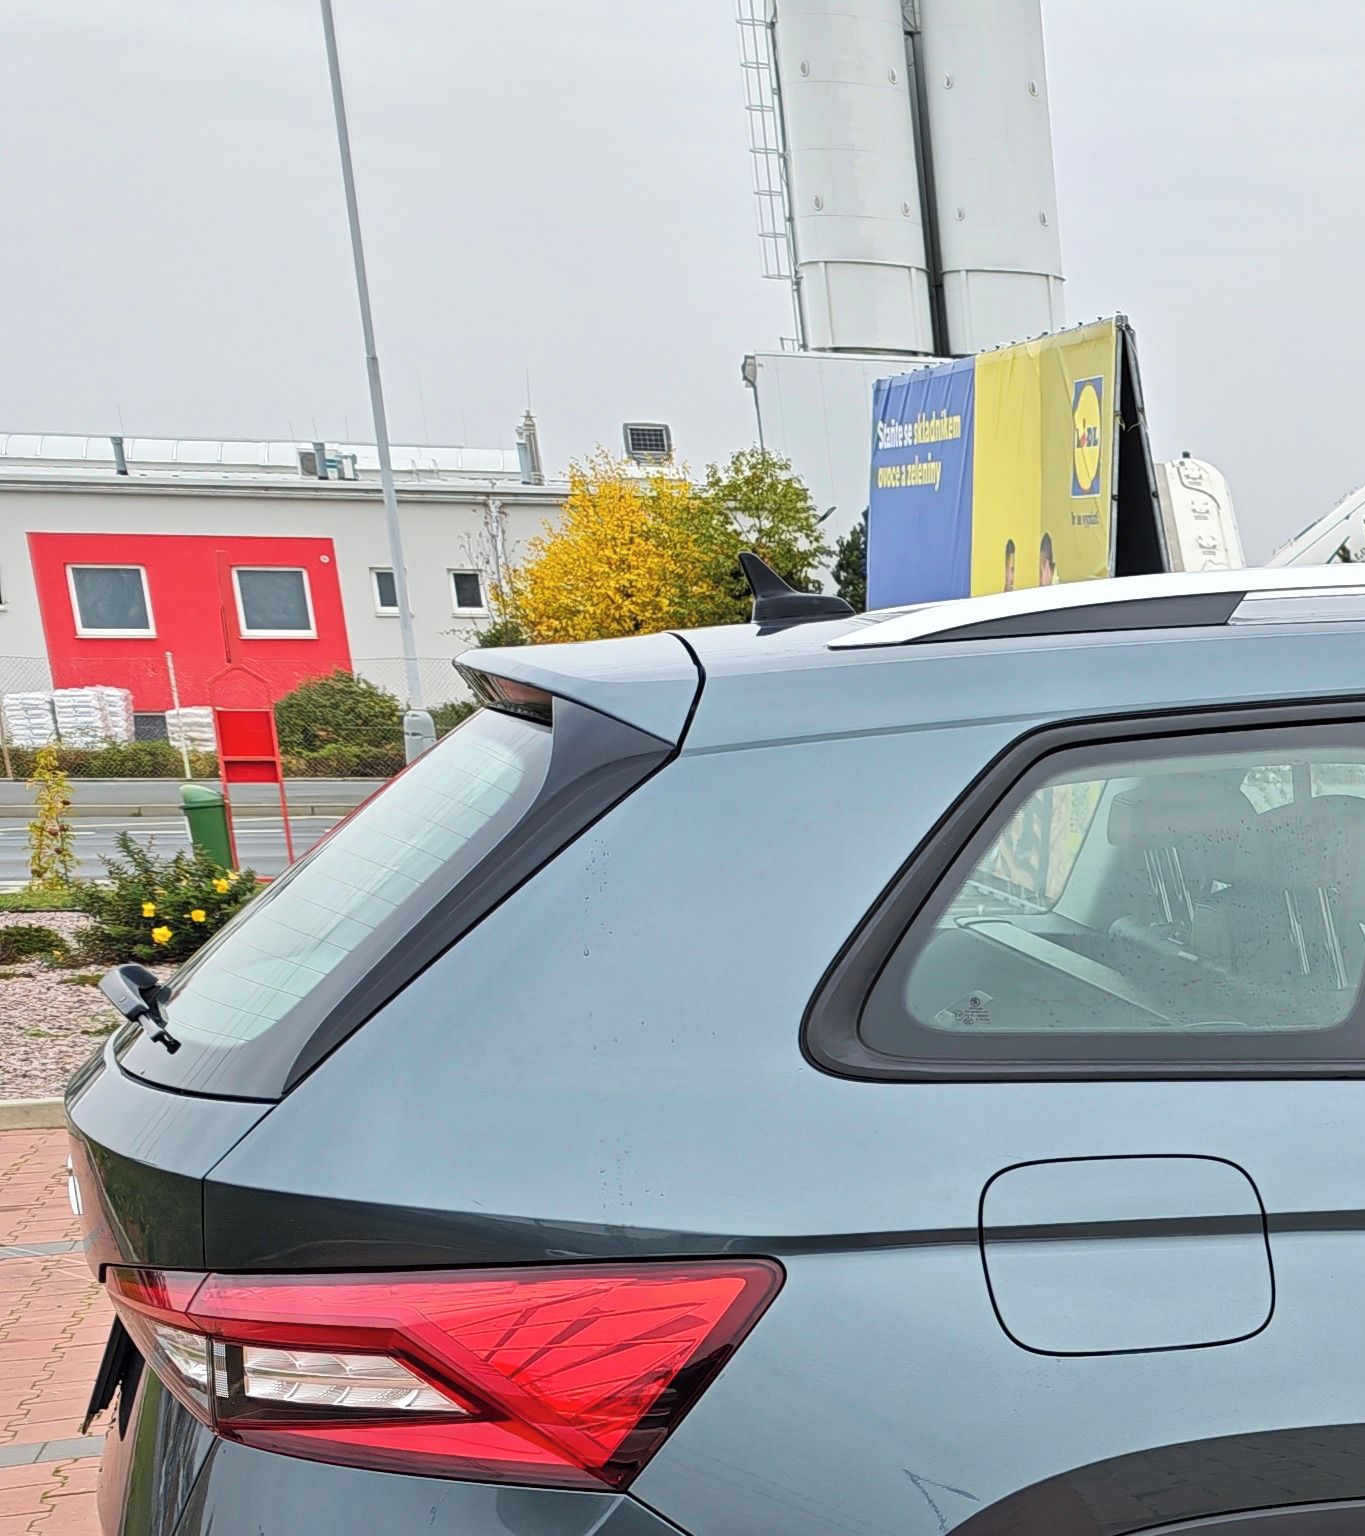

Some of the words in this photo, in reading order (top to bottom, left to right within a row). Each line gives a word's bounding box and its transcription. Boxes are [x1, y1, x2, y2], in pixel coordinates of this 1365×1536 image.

[877, 418, 903, 449] Staňte
[904, 422, 913, 446] se
[914, 408, 961, 445] skladníkem
[878, 465, 900, 488] ovoce
[907, 452, 942, 492] zeleniny
